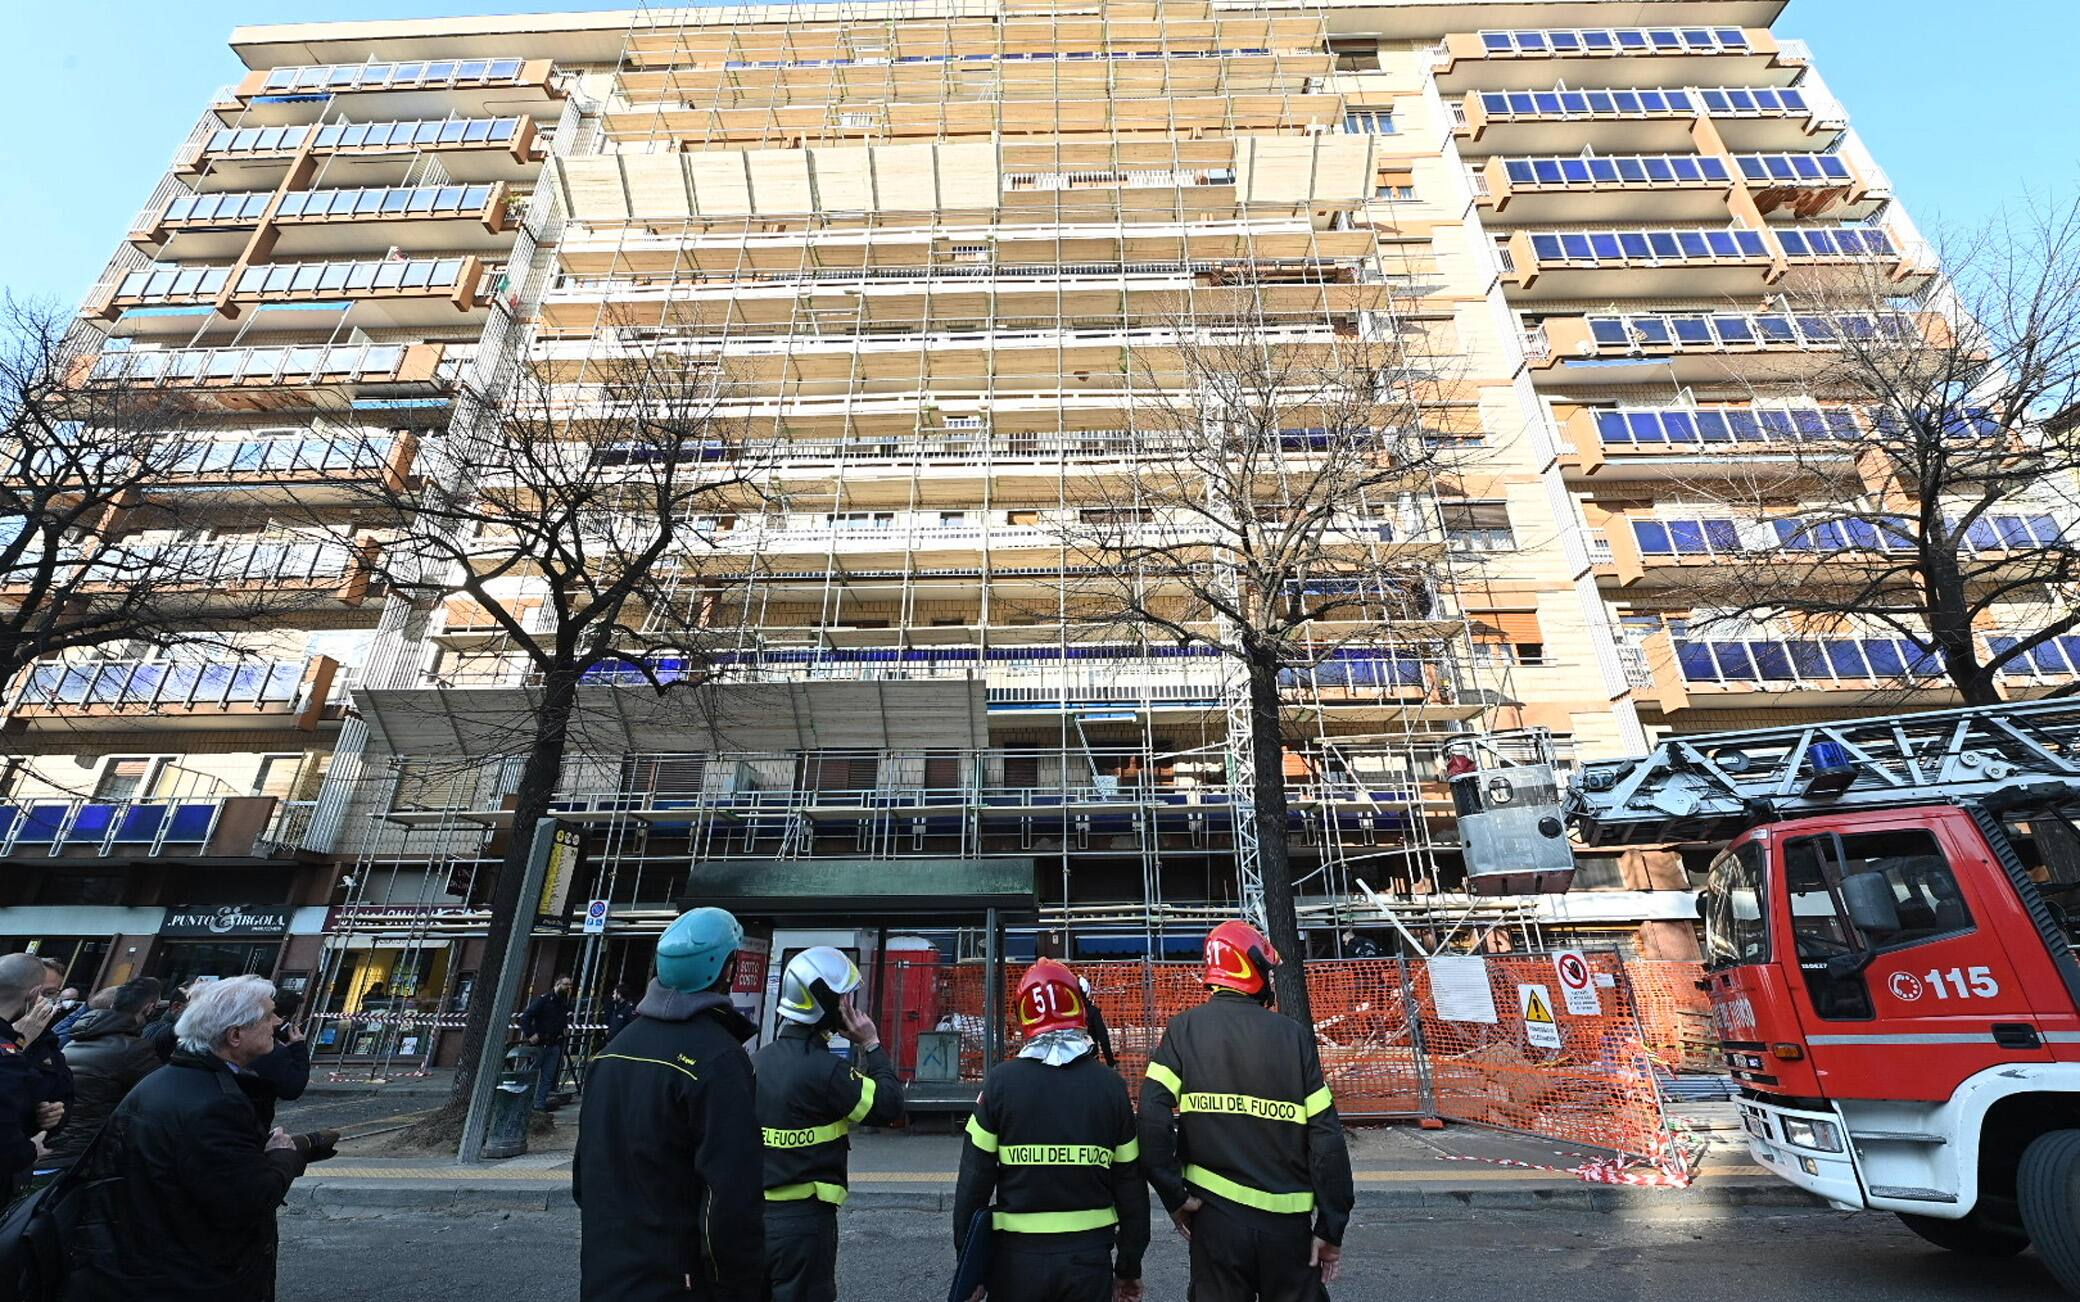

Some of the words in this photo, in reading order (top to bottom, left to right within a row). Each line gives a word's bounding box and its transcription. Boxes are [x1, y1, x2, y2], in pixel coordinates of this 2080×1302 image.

[1924, 966, 1999, 1000] 115
[1032, 983, 1057, 1014] 51
[1188, 1095, 1223, 1110] VIGILI
[1251, 1099, 1296, 1119] FUOCO
[773, 1129, 815, 1146] FUOCO
[1008, 1147, 1044, 1163] VIGILI
[1048, 1147, 1075, 1163] DEL
